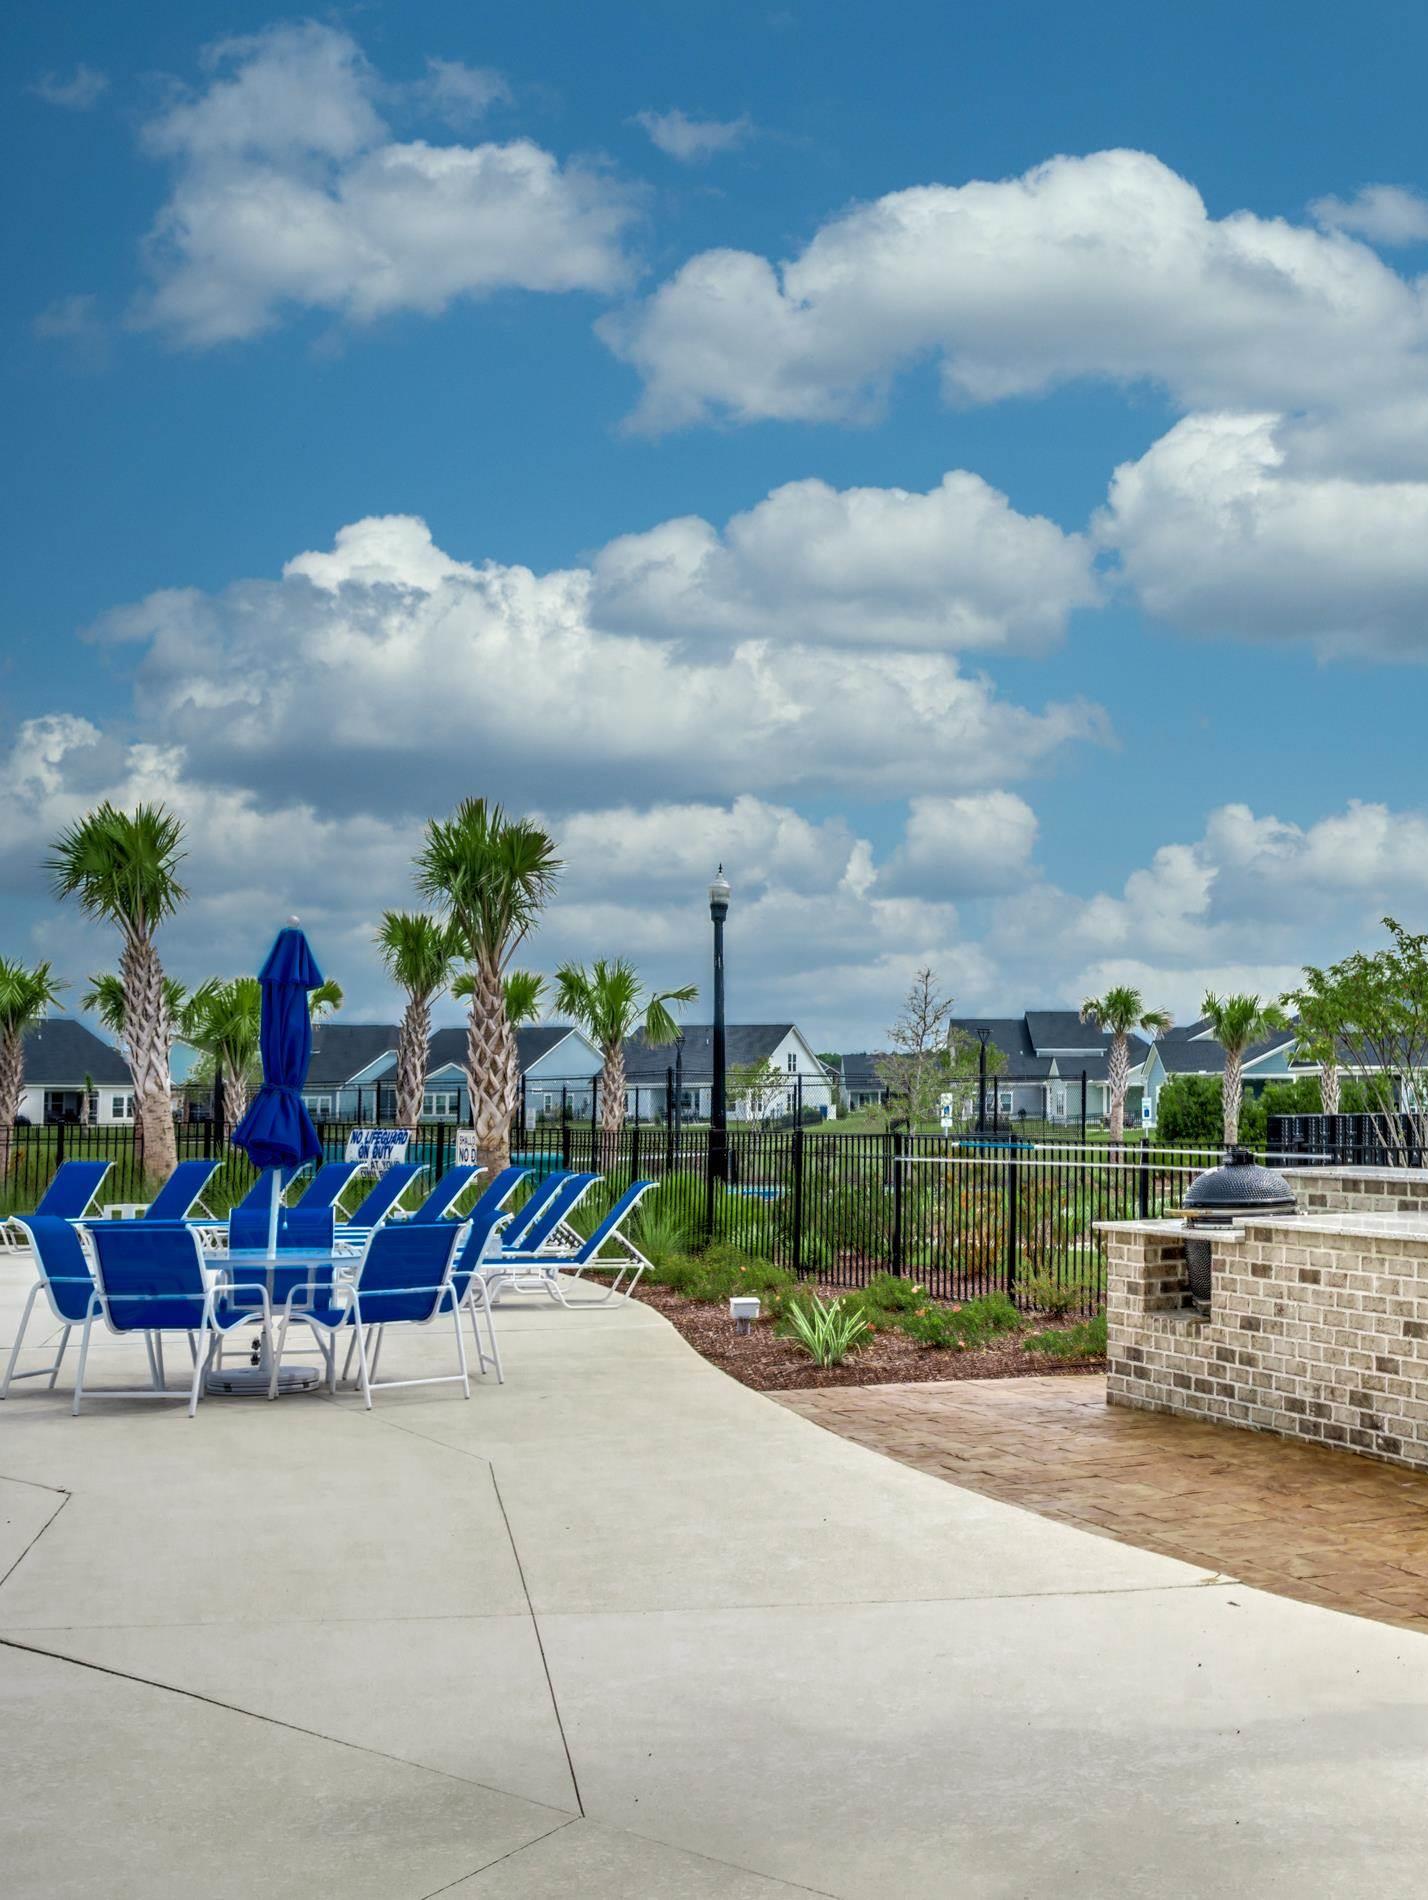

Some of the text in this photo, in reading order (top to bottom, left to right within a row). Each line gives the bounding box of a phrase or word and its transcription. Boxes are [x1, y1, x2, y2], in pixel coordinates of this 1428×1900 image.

[350, 1130, 409, 1145] NO LIFEGUARD
[459, 1135, 476, 1145] SHALLO
[358, 1145, 394, 1159] ON DUTY
[459, 1148, 469, 1162] NO
[370, 1160, 379, 1169] AT
